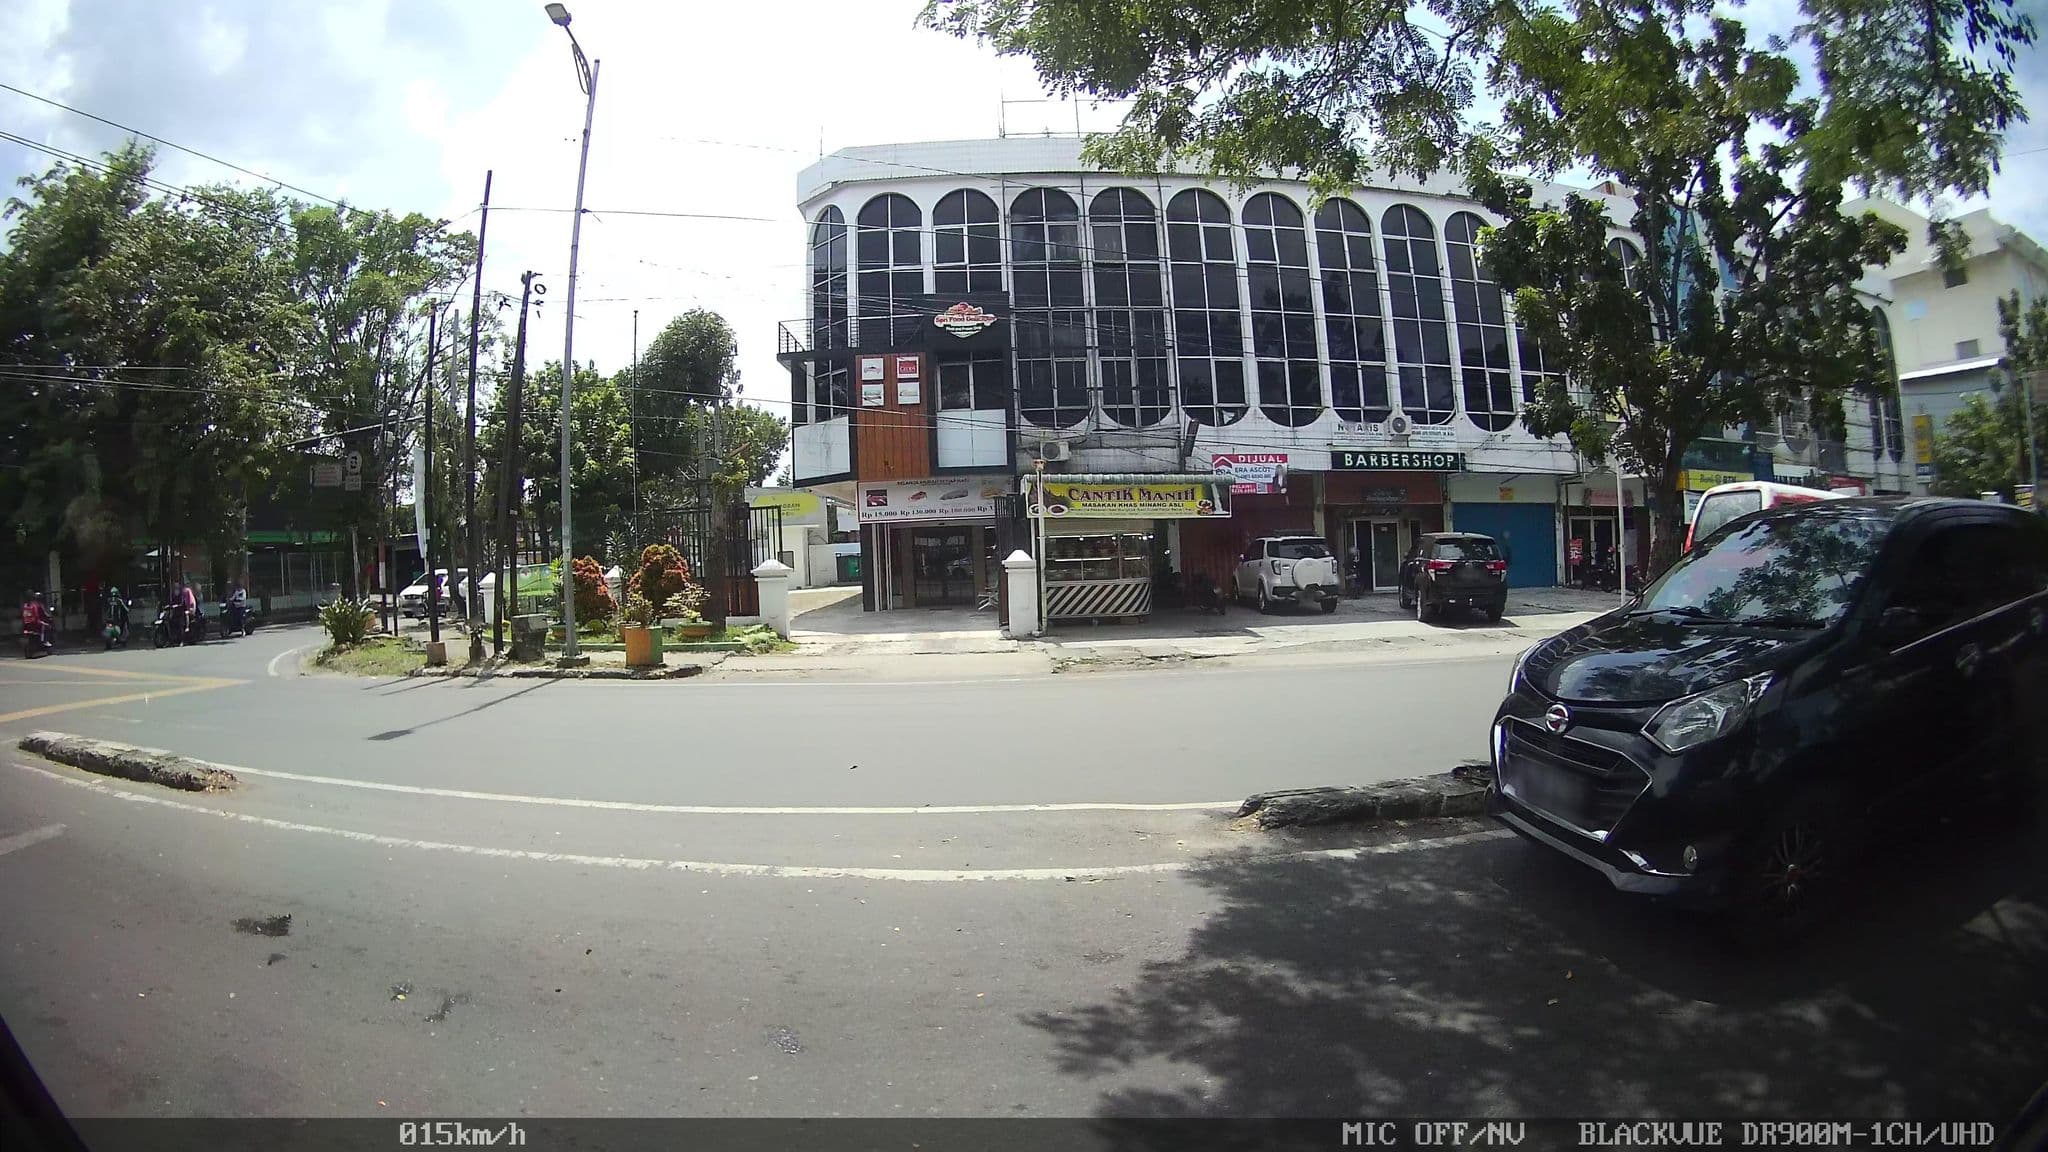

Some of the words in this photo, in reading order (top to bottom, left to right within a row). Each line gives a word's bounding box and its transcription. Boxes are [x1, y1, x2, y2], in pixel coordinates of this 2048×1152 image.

[1337, 423, 1379, 432] NAIS
[1238, 455, 1283, 463] DIJUAL
[1344, 453, 1454, 468] BARBERSHOP
[1068, 487, 1134, 501] CANTIK
